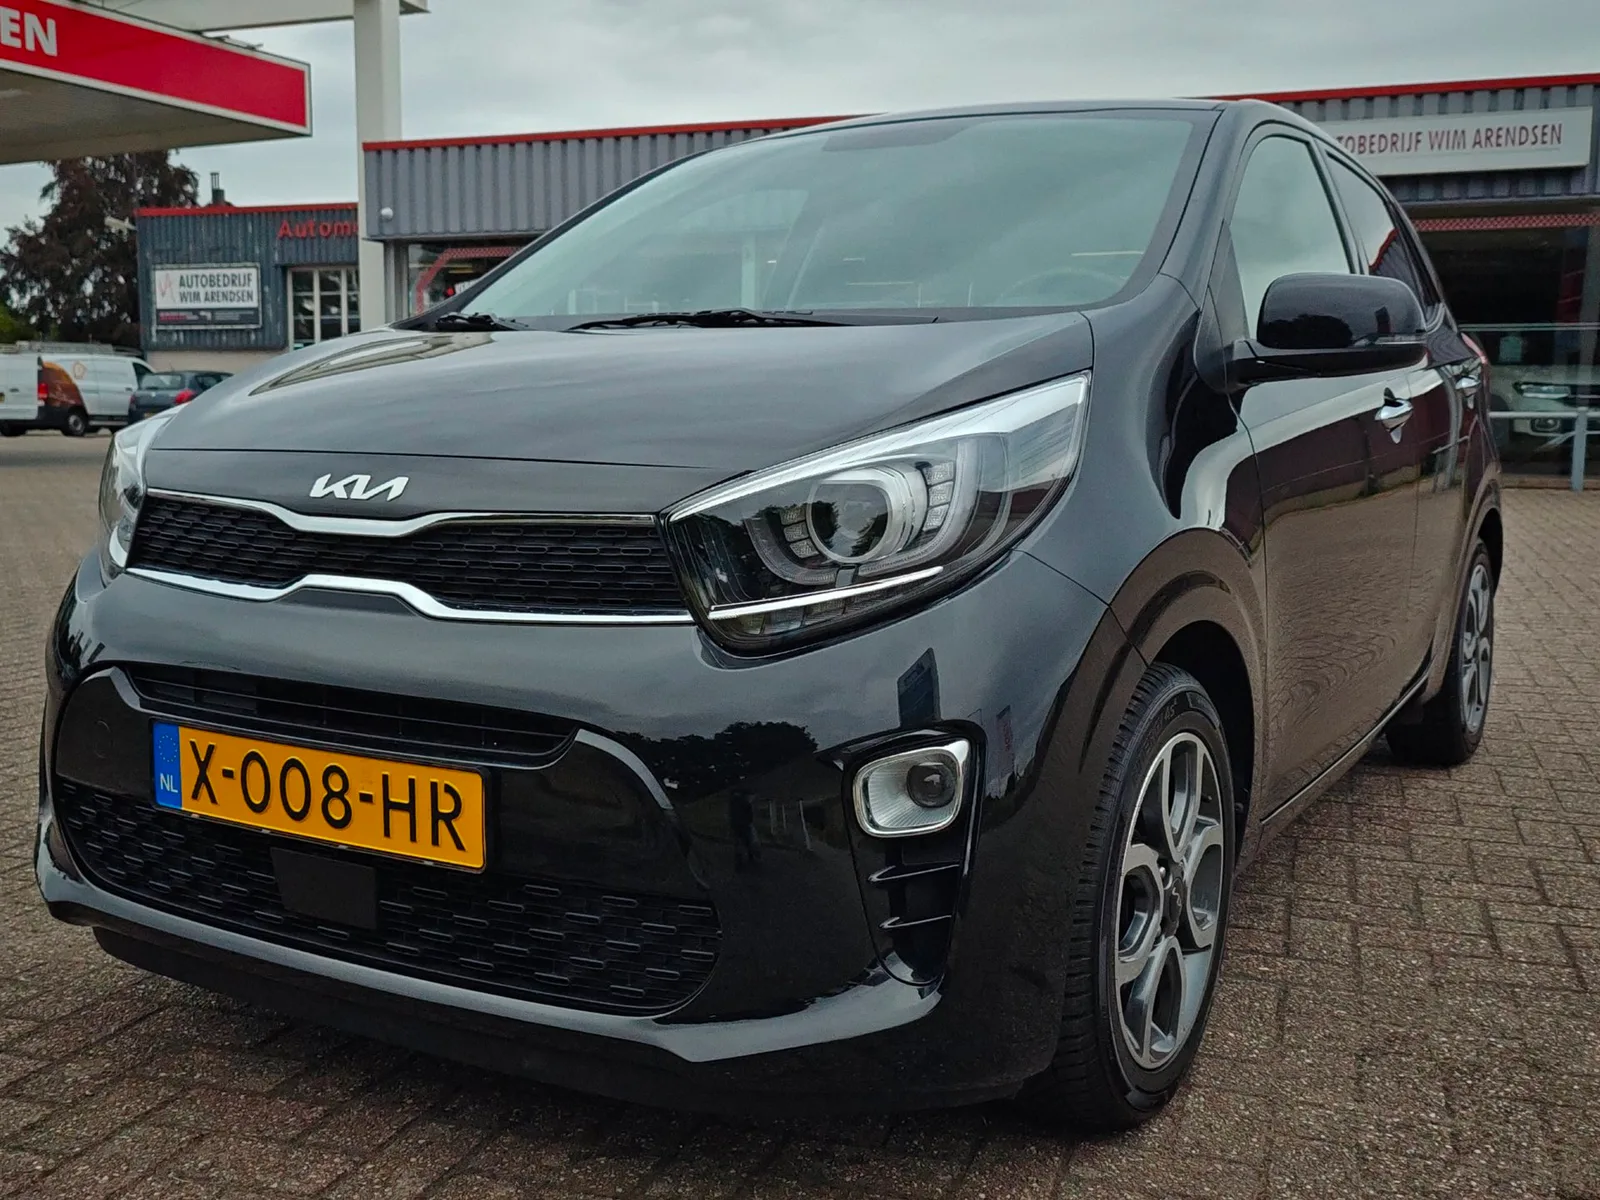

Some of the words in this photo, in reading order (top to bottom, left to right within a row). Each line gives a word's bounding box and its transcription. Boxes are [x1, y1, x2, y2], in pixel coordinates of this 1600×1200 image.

[0, 5, 58, 57] EN
[1428, 128, 1466, 151] WIM
[1472, 123, 1562, 149] ARENDSEN
[179, 273, 252, 288] AUTOBEDRIJF
[180, 291, 201, 303] WIM
[204, 290, 253, 303] ARENDSEN
[309, 473, 409, 501] KIA
[160, 773, 178, 793] NL
[189, 738, 467, 852] X-008-HR
